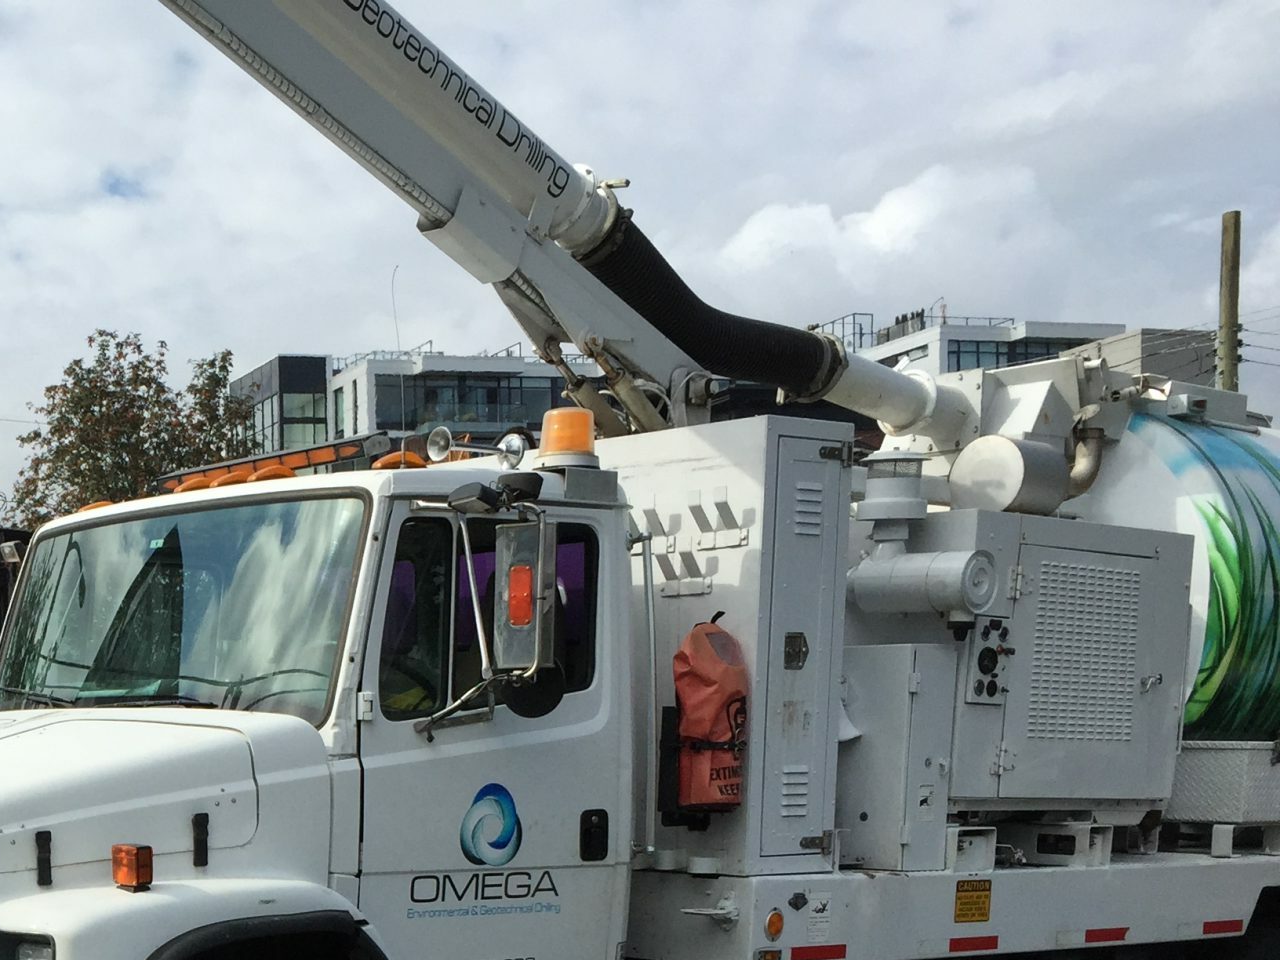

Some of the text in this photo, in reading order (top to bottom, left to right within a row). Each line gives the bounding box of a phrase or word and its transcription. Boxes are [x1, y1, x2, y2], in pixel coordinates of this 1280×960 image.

[496, 109, 570, 198] Drilling
[410, 870, 559, 903] OMEGA
[958, 881, 990, 891] CAUTION
[406, 902, 561, 919] Environmental & Geotechnical Drilling
